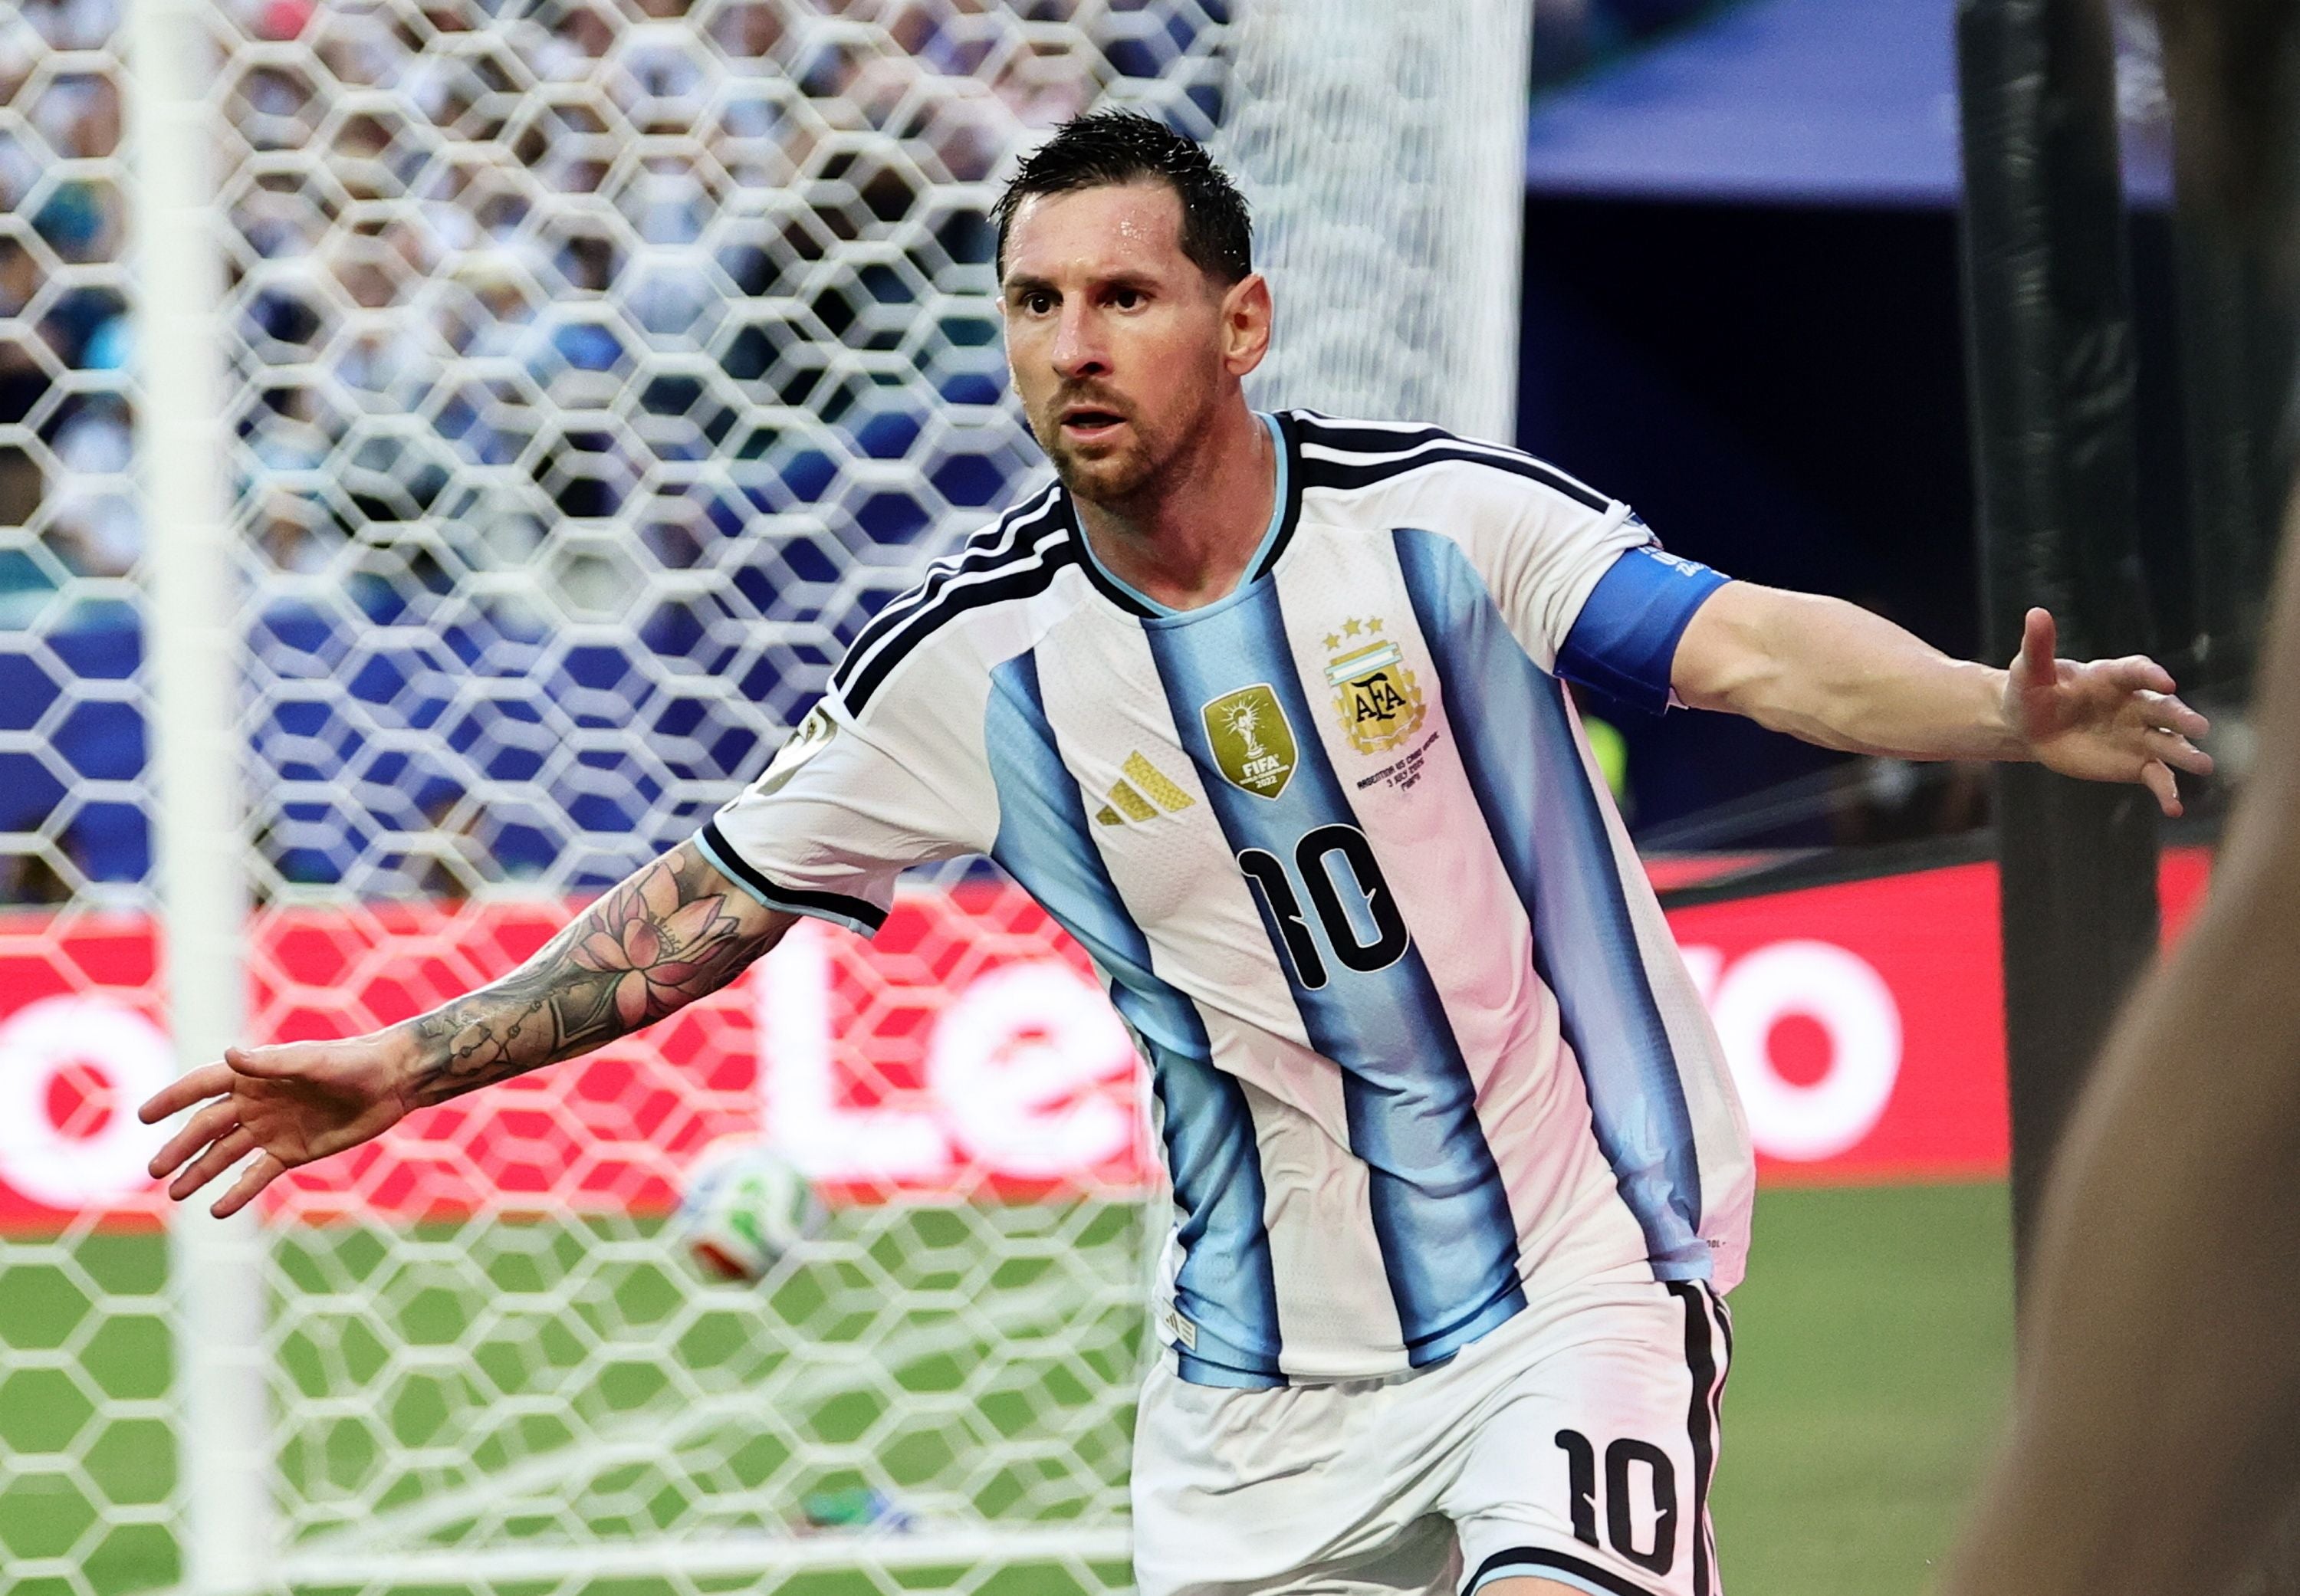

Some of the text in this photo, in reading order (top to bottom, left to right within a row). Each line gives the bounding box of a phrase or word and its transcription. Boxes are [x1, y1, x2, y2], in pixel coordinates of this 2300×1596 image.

[1351, 672, 1406, 722] AFA
[1242, 754, 1280, 777] FIFA
[1255, 774, 1278, 789] 2022
[1236, 823, 1411, 991] 10
[1554, 1428, 1678, 1578] 10
